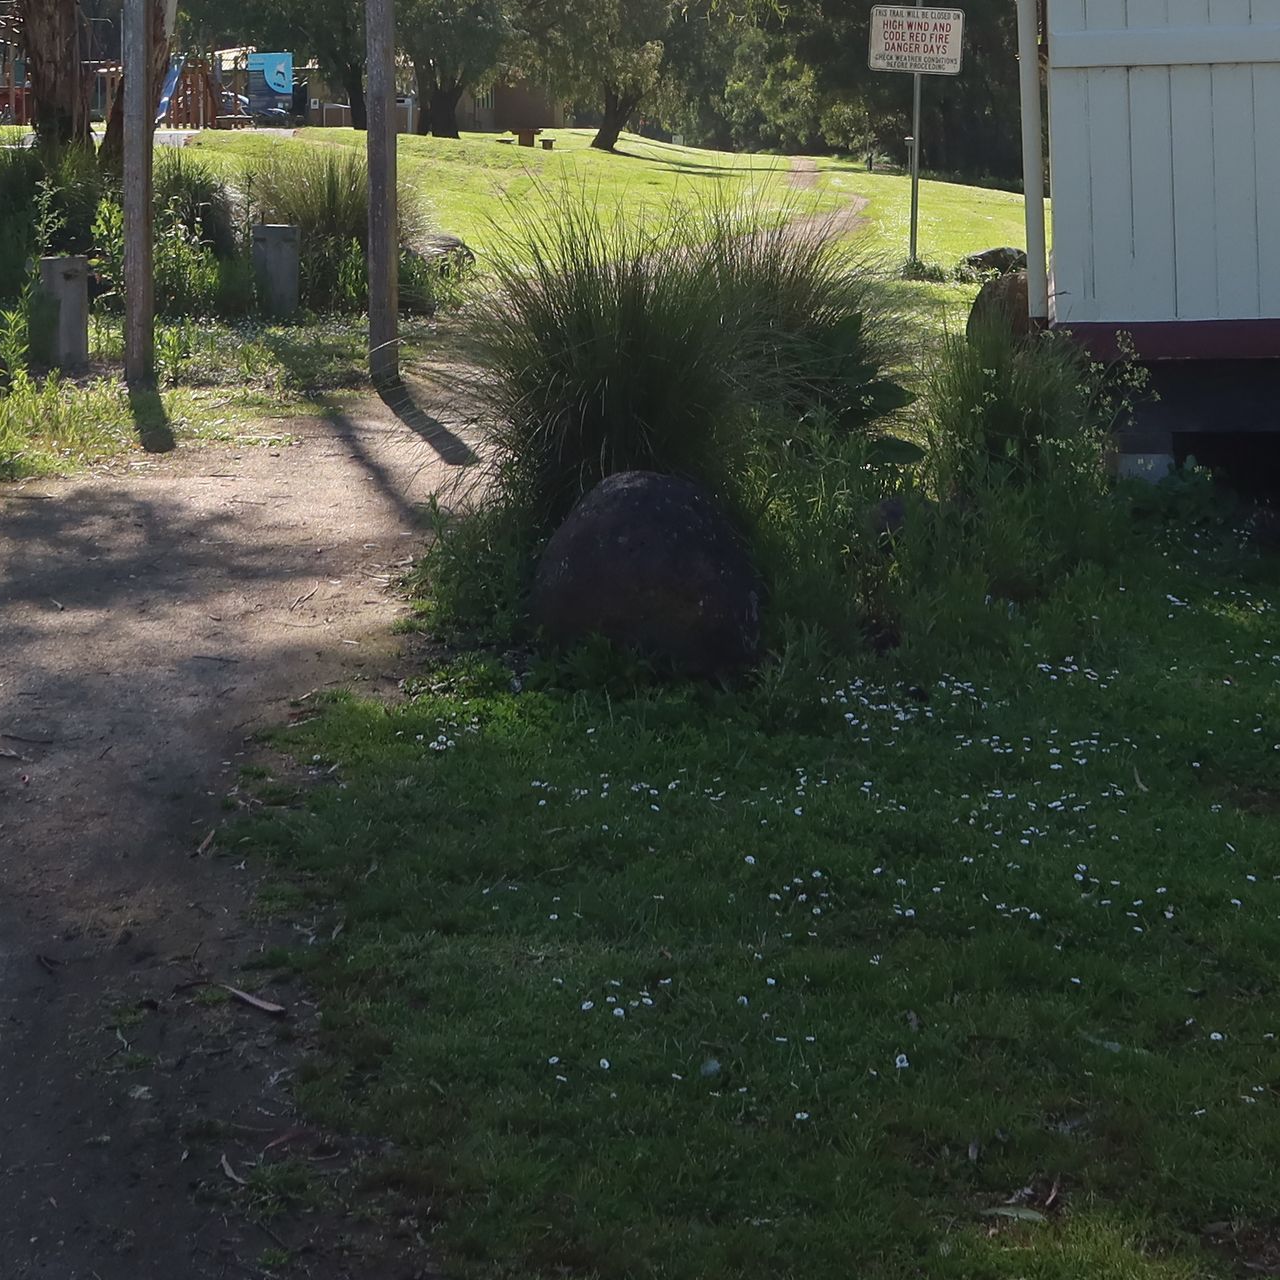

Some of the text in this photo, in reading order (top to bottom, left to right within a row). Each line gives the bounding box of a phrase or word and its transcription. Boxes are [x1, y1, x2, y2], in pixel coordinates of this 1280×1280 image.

[875, 9, 961, 21] THIS TRAIL WILL BE CLOSED ON
[882, 20, 952, 33] HIGH WIND AND
[883, 30, 950, 44] CODE RED FIRE
[884, 41, 947, 55] DANGER DAYS
[875, 53, 957, 65] CHECK WEATHER CONDITIONS
[886, 61, 946, 71] BEFORE PROCEEDING
